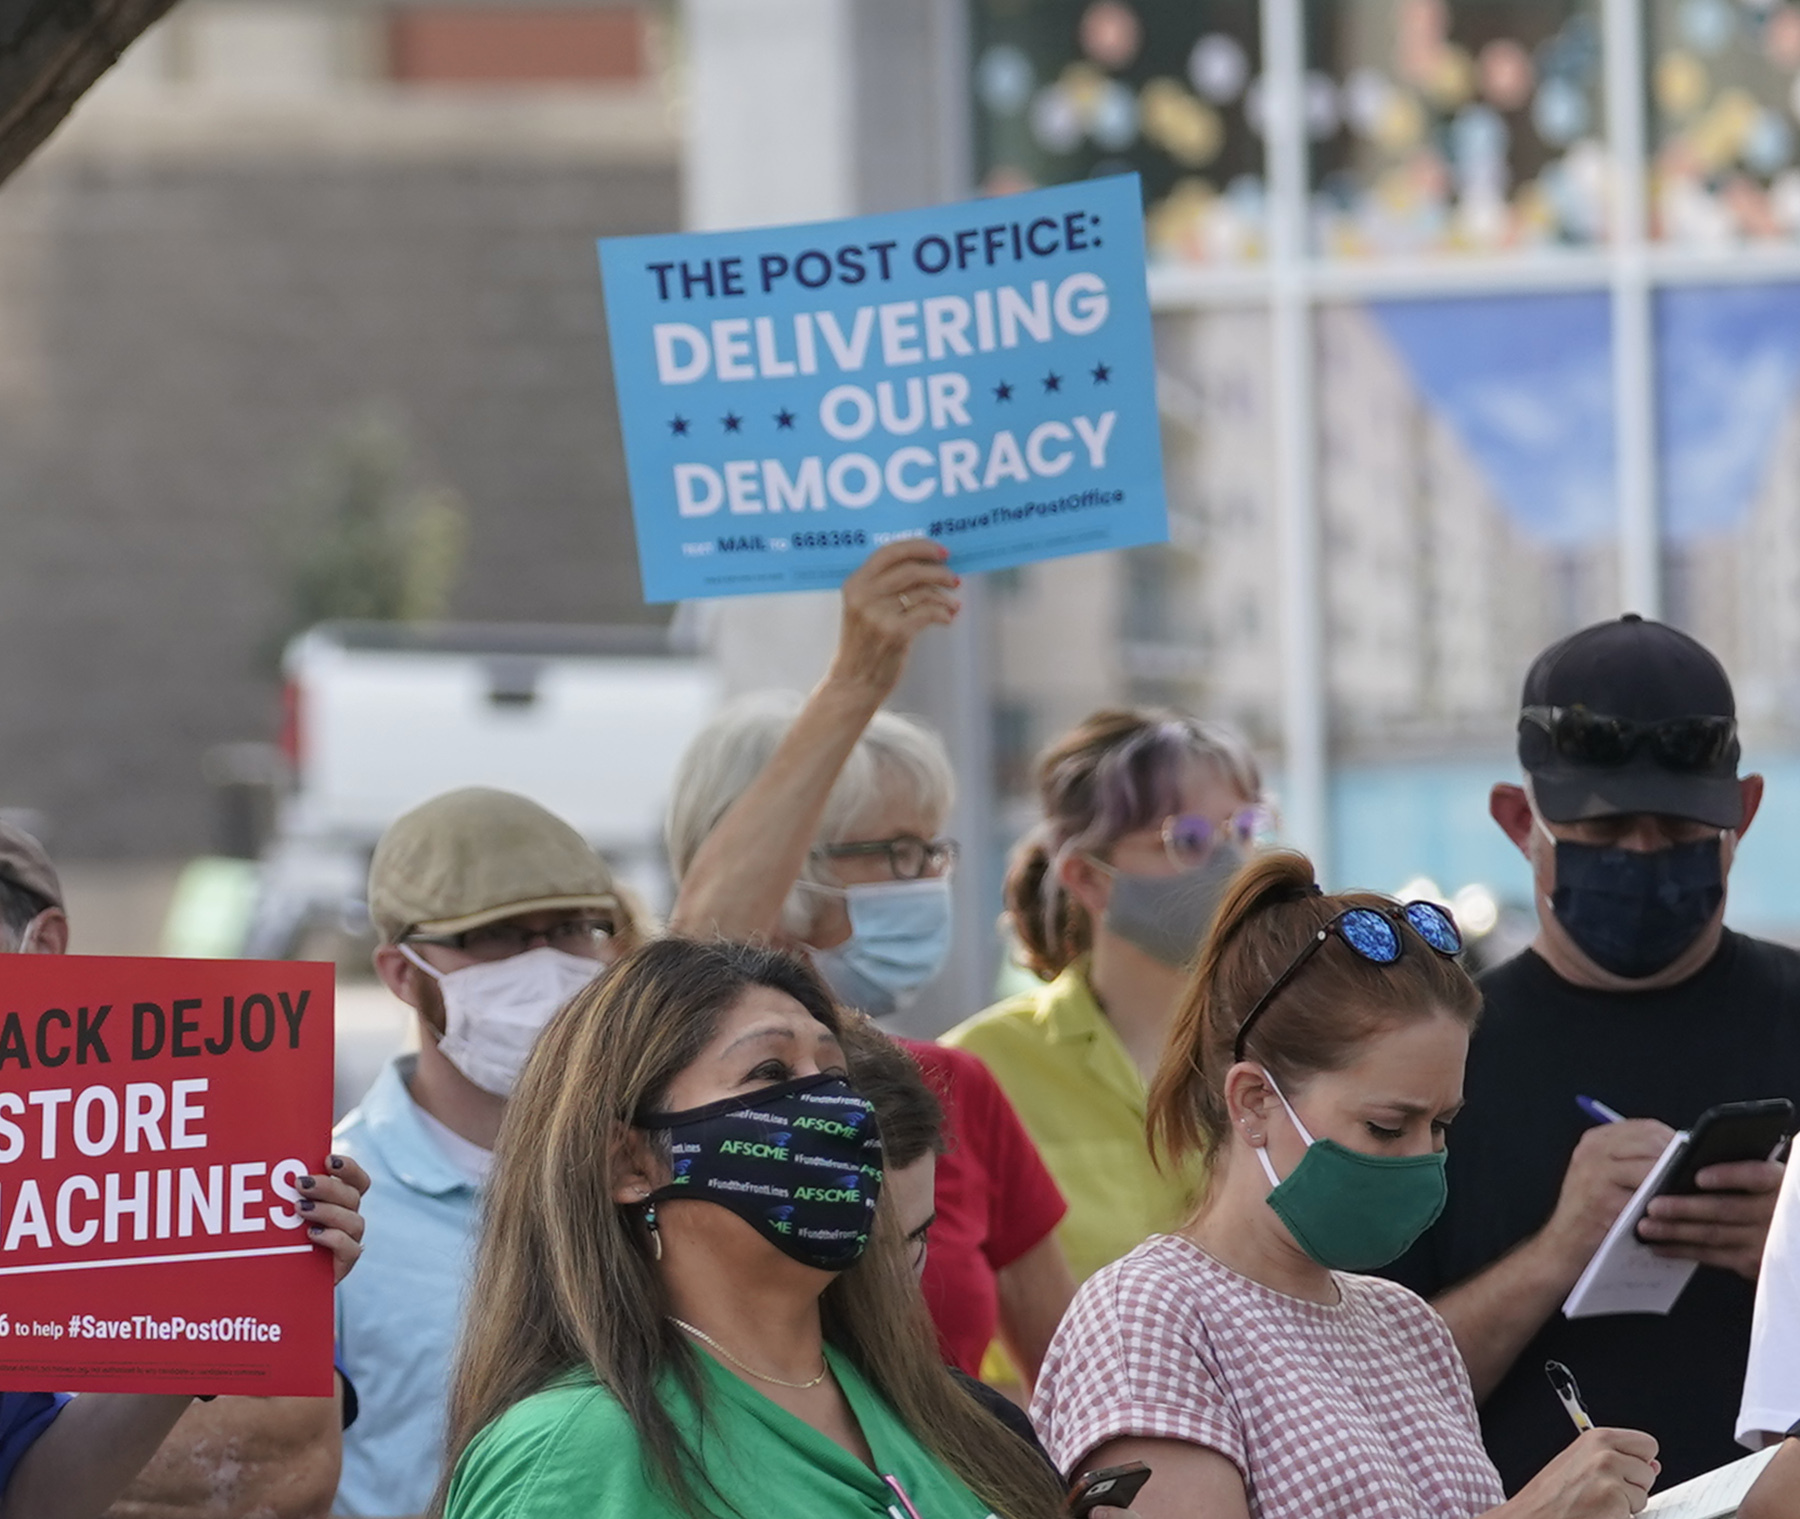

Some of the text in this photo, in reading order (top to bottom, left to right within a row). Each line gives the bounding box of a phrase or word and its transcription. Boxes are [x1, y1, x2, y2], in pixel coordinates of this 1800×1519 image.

[646, 211, 1104, 301] THE POST OFFICE:
[652, 272, 1110, 385] DELIVERING
[818, 372, 973, 441] OUR
[672, 411, 1118, 517] DEMOCRACY
[717, 536, 767, 552] MAIL
[929, 488, 1126, 538] #SaveThePostOffice
[131, 990, 311, 1061] DEJOY
[720, 1140, 790, 1161] AFSCME
[793, 1116, 860, 1140] AFSCME
[794, 1187, 861, 1202] AFSCME
[15, 1322, 30, 1336] to
[33, 1321, 63, 1340] help
[68, 1315, 282, 1343] #SaveThePostOffice
